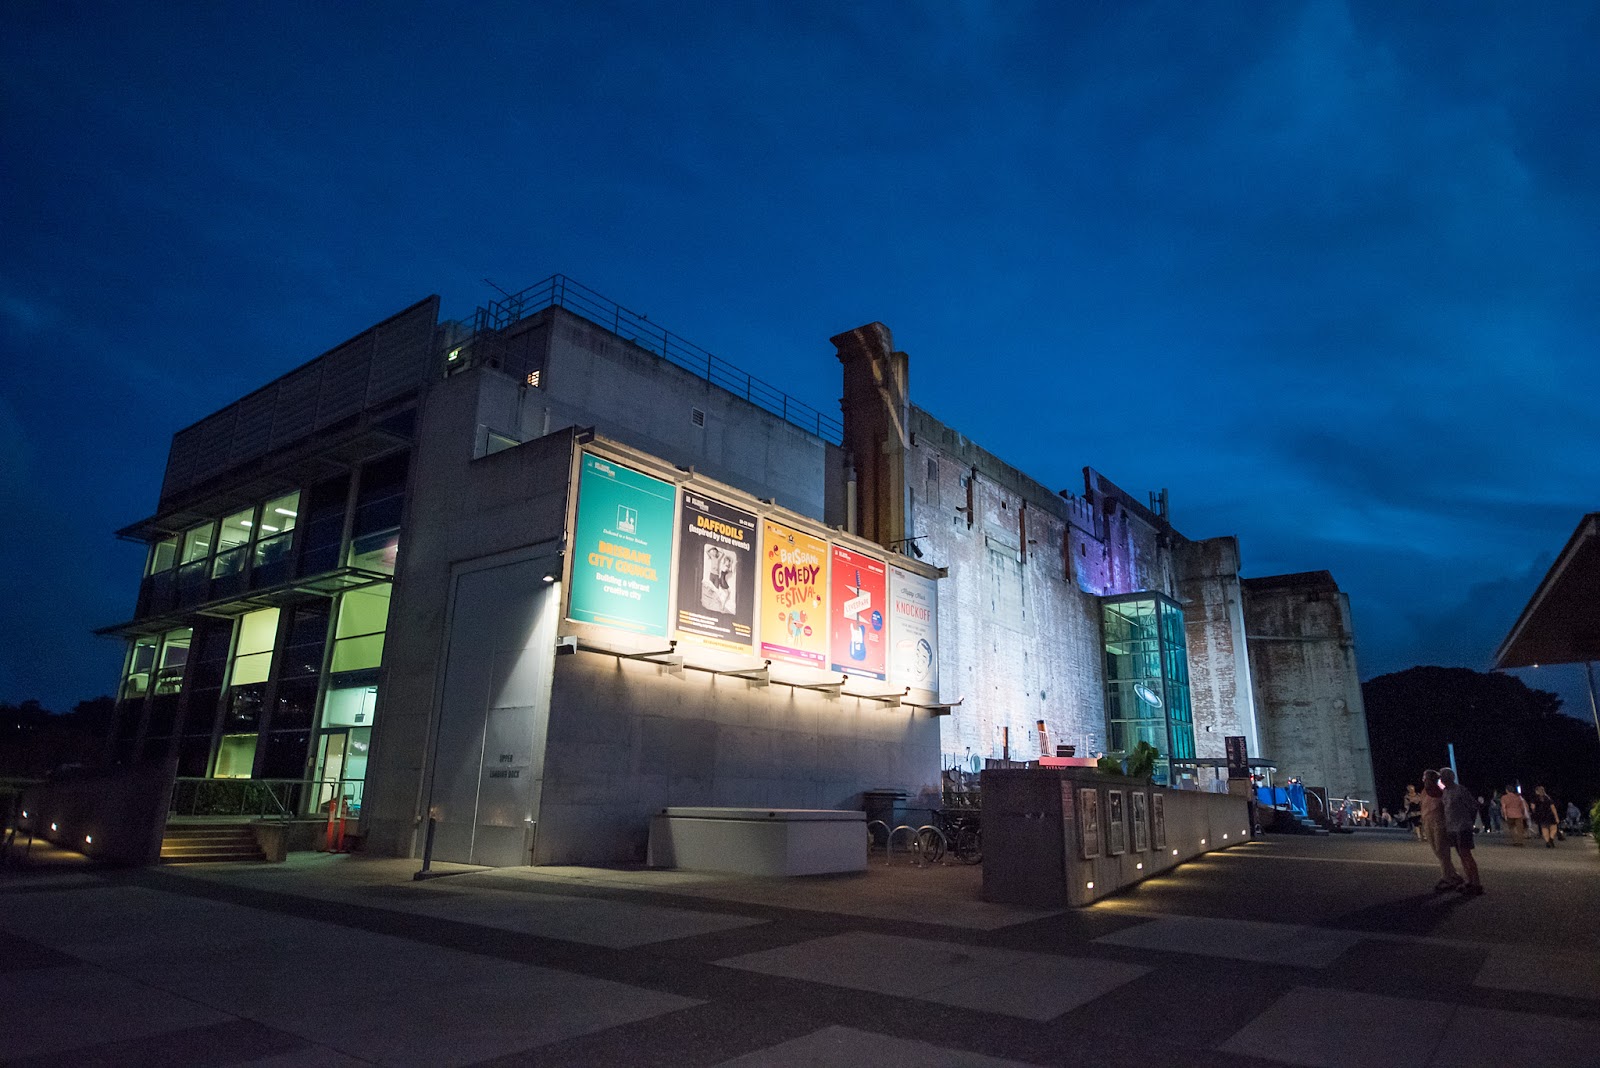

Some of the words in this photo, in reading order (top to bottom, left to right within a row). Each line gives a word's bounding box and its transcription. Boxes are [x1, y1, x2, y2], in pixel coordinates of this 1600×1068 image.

[697, 515, 744, 541] DAFFODILS
[713, 531, 720, 542] by
[720, 534, 732, 544] true
[731, 539, 750, 551] events)
[598, 540, 651, 566] BRISBANE
[588, 552, 614, 569] CITY
[615, 560, 658, 582] COUNCIL
[772, 563, 820, 592] COMEDY
[596, 572, 622, 587] Building
[628, 581, 650, 592] vibrant
[603, 585, 629, 598] creative
[629, 591, 642, 600] city
[776, 586, 816, 608] FESTIVAL
[896, 600, 931, 622] KNOCKOFF
